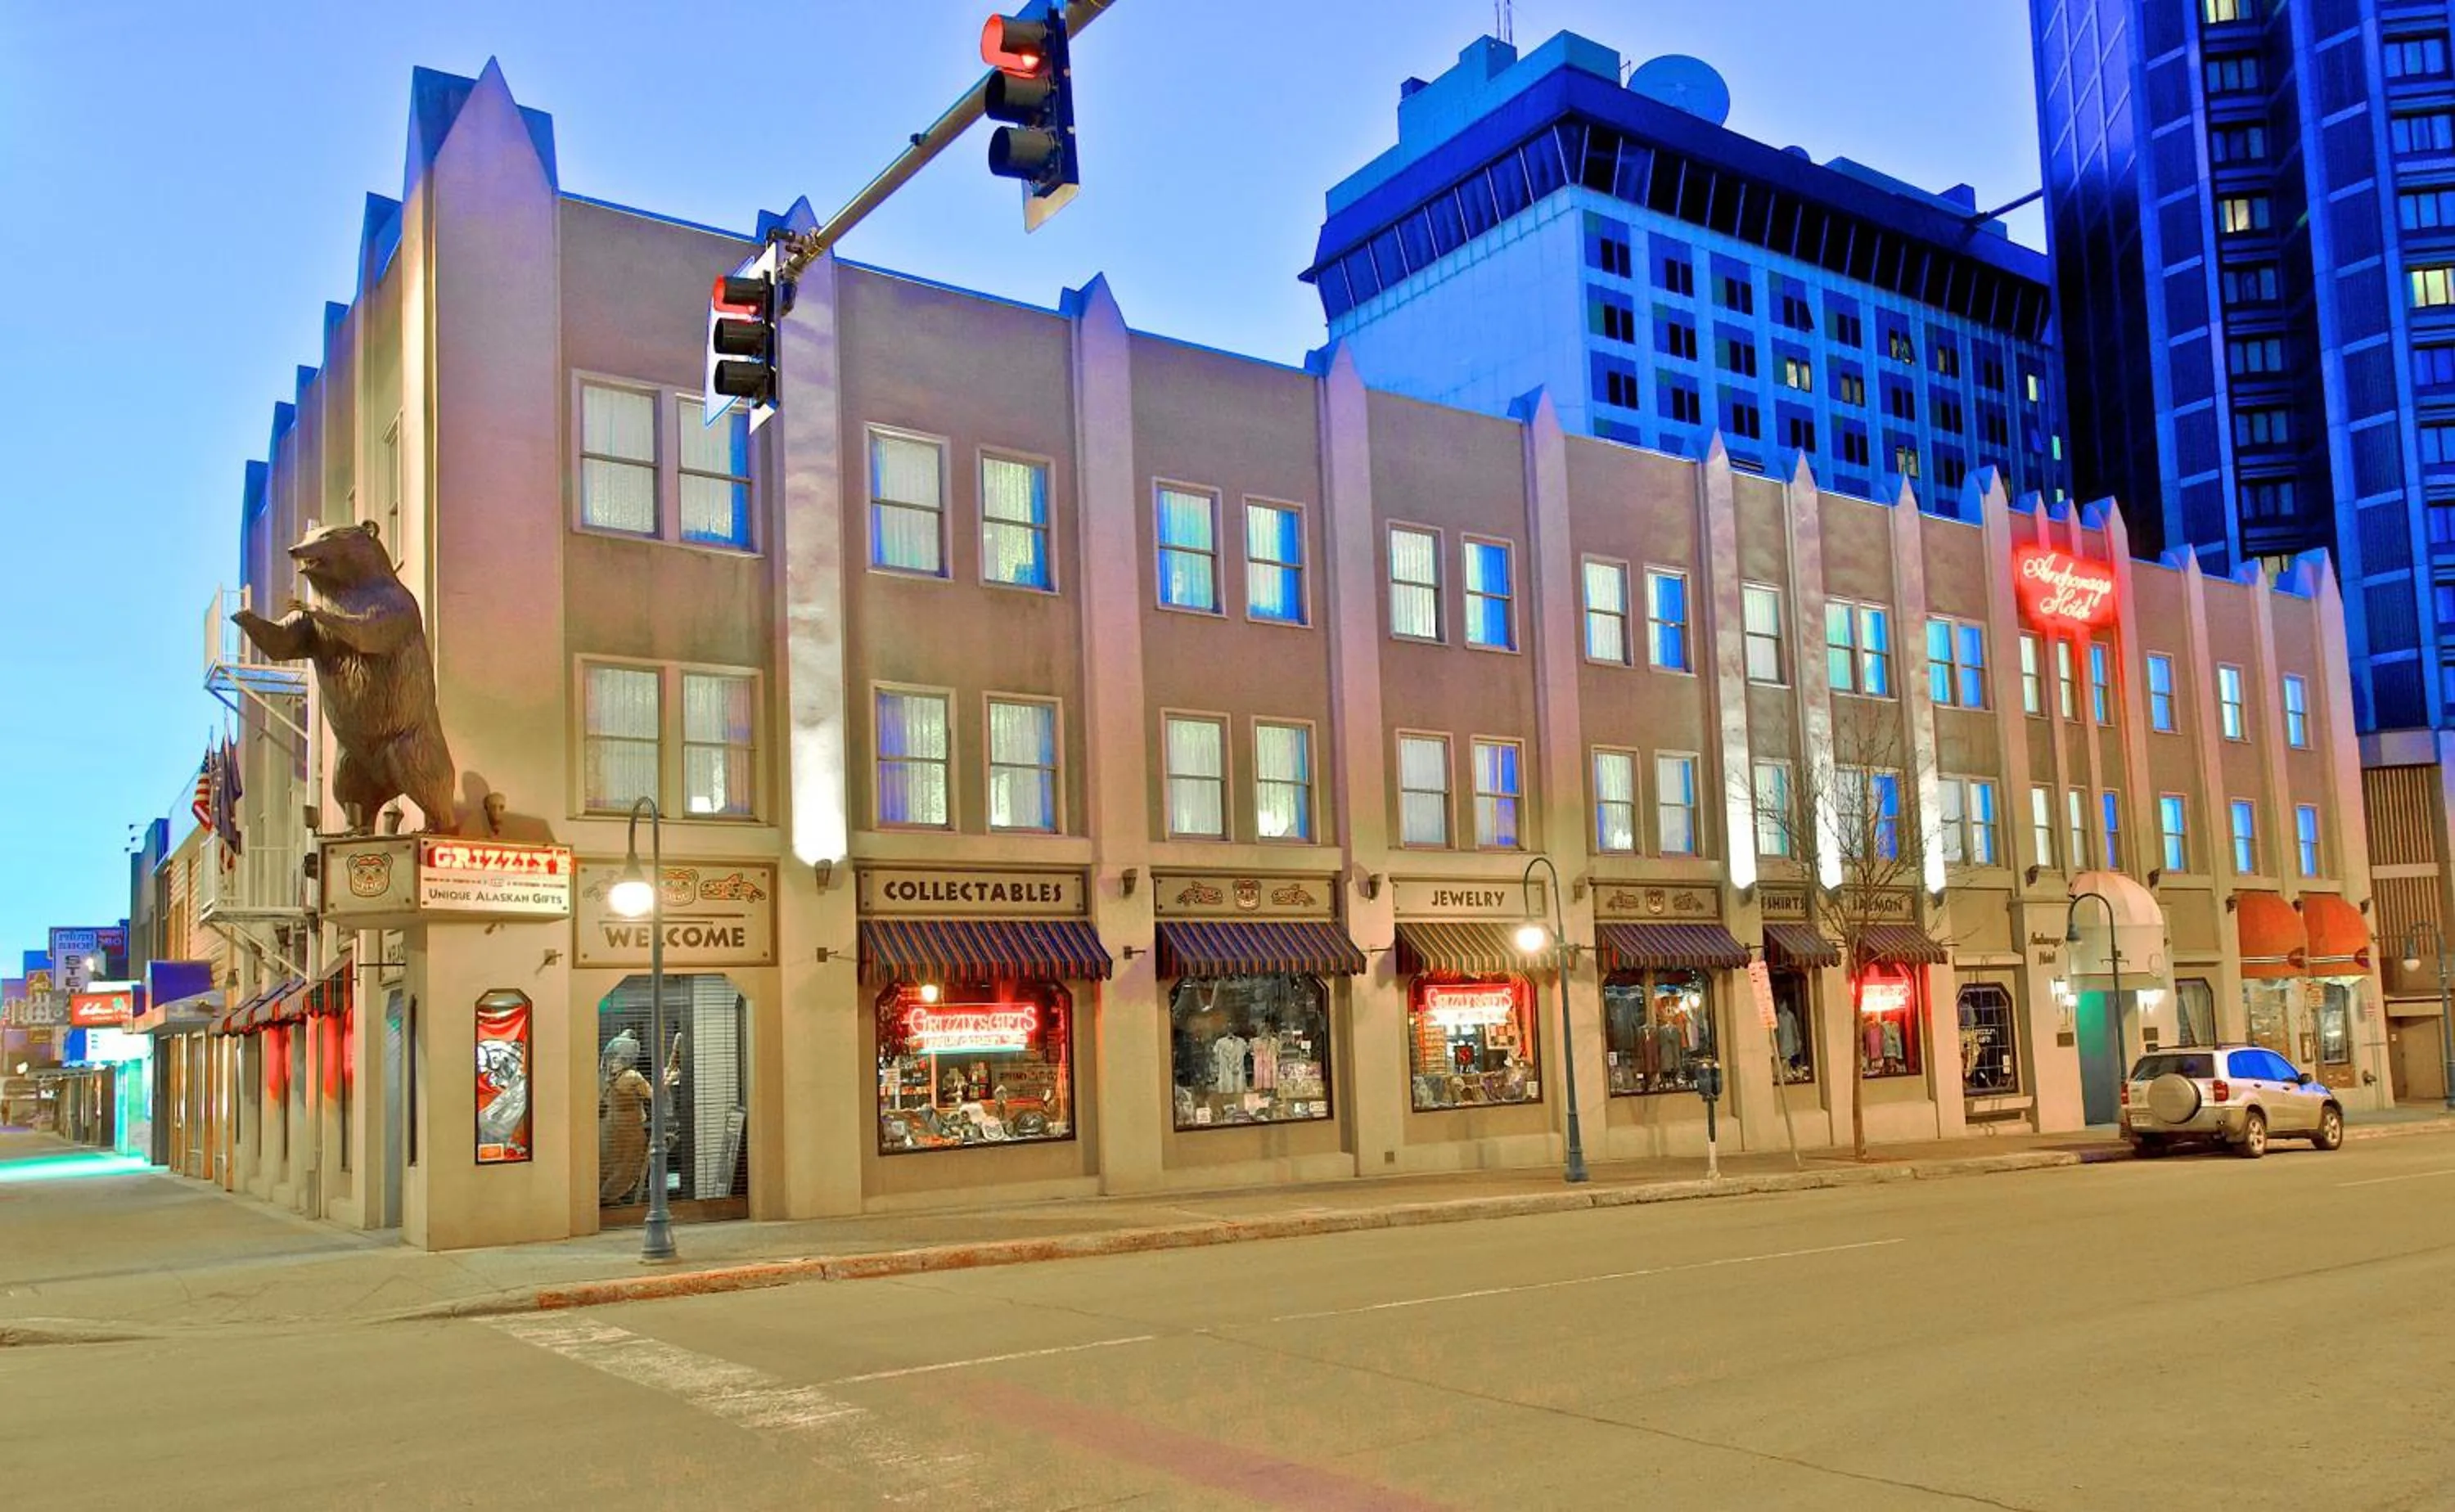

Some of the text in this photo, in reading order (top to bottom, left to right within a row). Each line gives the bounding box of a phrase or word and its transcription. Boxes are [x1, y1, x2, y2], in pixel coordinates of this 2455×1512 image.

[2039, 588, 2091, 619] Hotel
[435, 846, 574, 875] GRIZZLY'S
[883, 880, 1062, 902] COLLECTABLES
[1431, 889, 1505, 907] JEWELRY
[604, 926, 746, 948] WECOME
